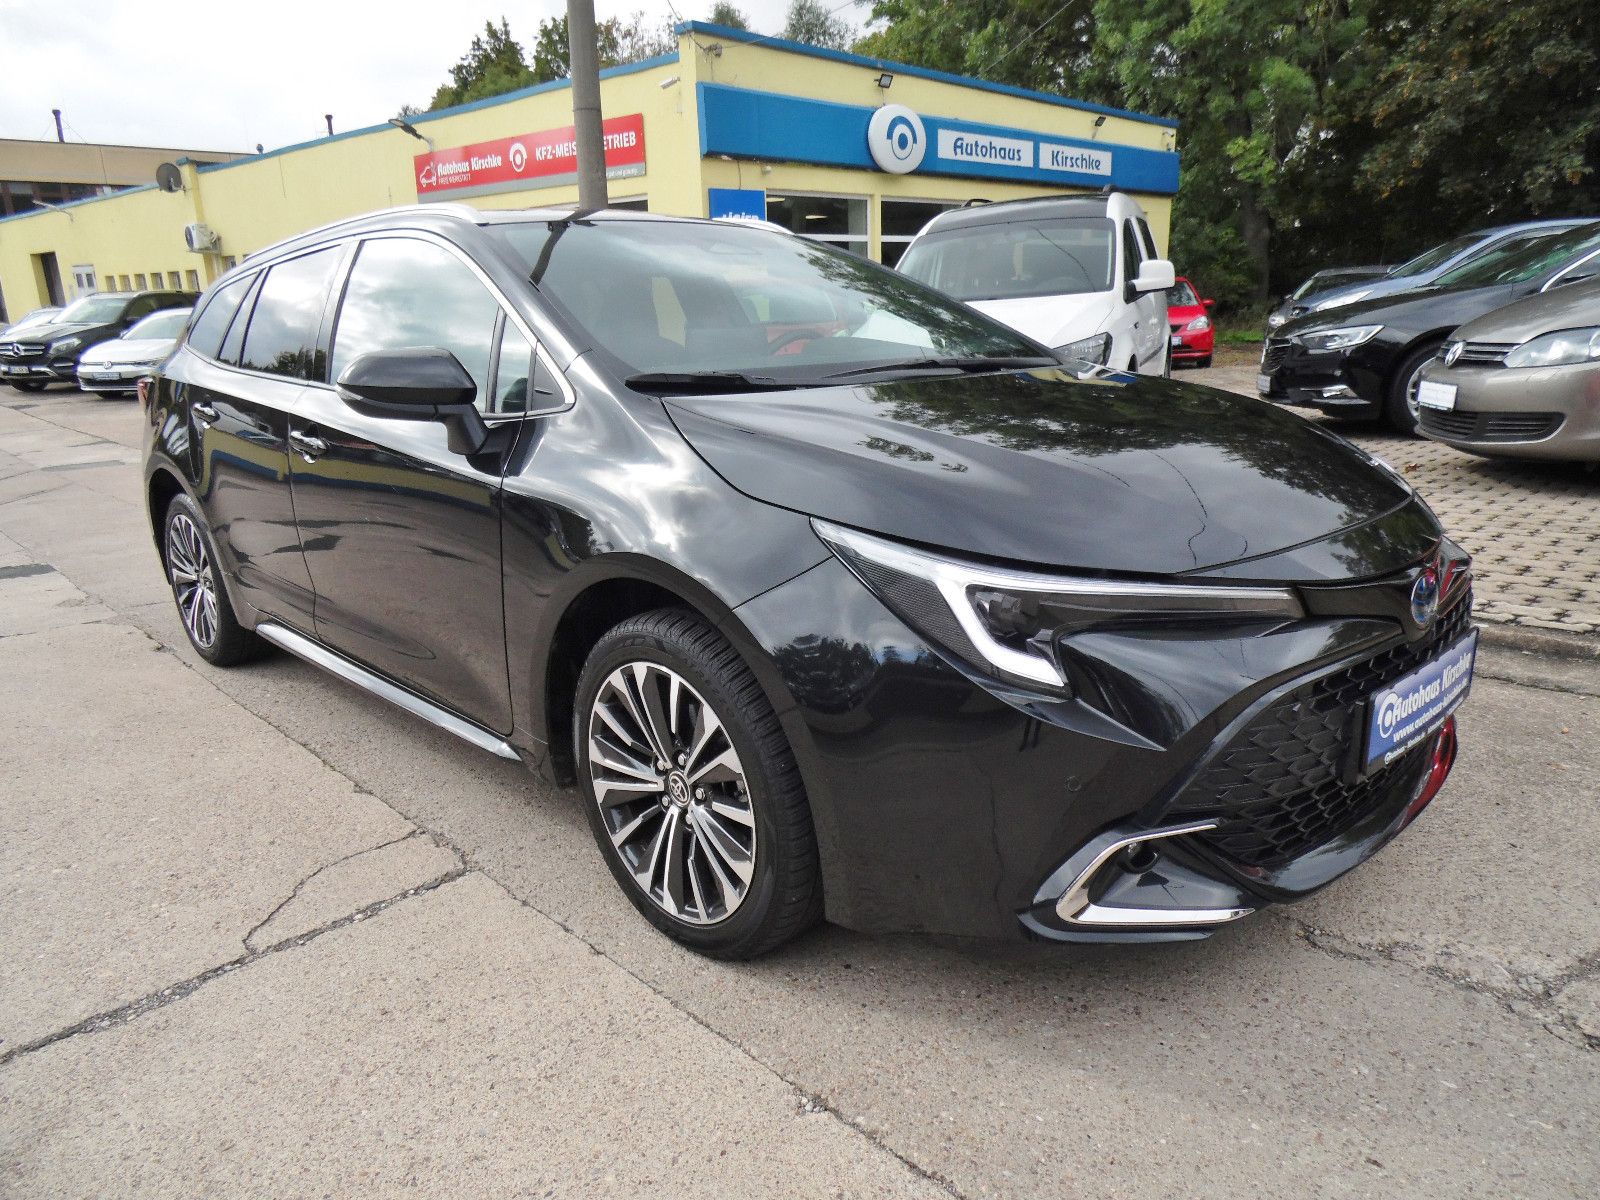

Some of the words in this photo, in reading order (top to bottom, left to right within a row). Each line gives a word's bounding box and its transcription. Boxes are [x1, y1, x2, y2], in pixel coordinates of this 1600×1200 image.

[437, 161, 470, 177] Autohaus
[471, 154, 502, 171] Kirschke
[953, 137, 1022, 162] Autohaus
[1051, 149, 1101, 171] Kirschke
[1392, 678, 1441, 726] Autohaus
[1442, 652, 1471, 691] Kirschke
